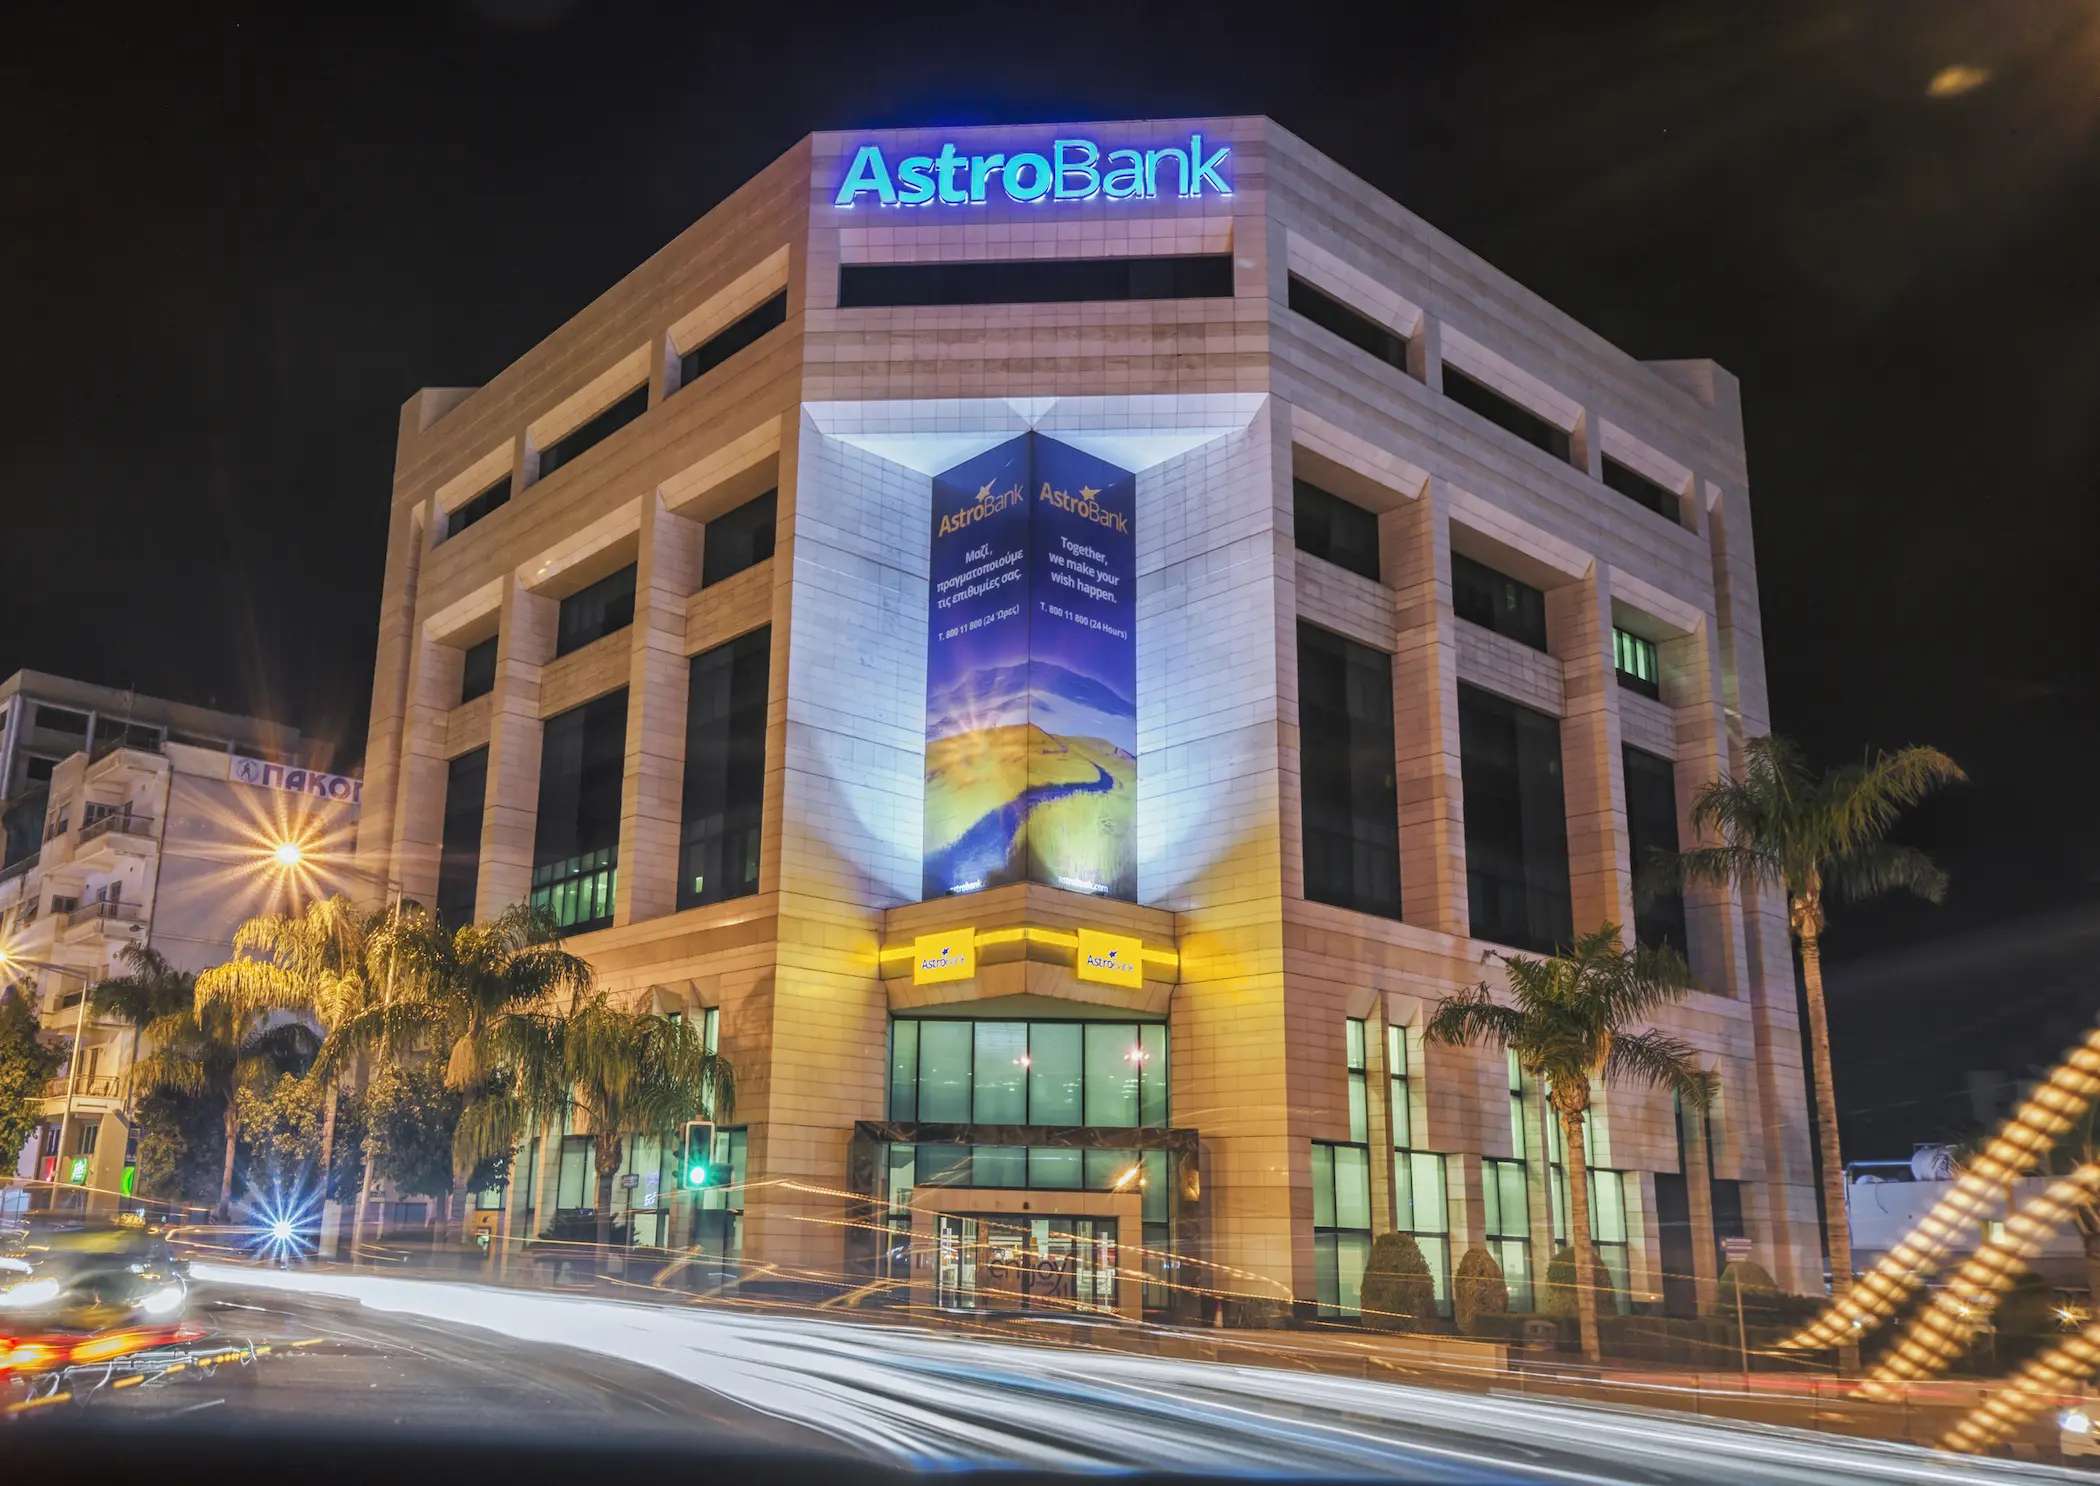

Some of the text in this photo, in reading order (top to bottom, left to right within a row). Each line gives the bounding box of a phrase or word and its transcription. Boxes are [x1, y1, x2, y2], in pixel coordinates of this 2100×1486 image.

[835, 134, 1232, 207] AstroBank
[938, 484, 1024, 538] AstroBank
[1040, 481, 1129, 535] AstroBank
[965, 543, 993, 564] Μαζί,
[1061, 536, 1108, 566] Together,
[937, 549, 1024, 593] πραγματοποιούμε
[1048, 552, 1119, 586] we make your
[937, 597, 951, 609] τις
[952, 576, 1000, 604] επιθυμίες
[1051, 571, 1117, 603] wish happen.
[945, 627, 959, 639] 800
[960, 624, 968, 634] 11
[969, 618, 983, 631] 800
[983, 614, 995, 626] (24
[1040, 601, 1128, 640] T. 800 11 800 (24 Hours)
